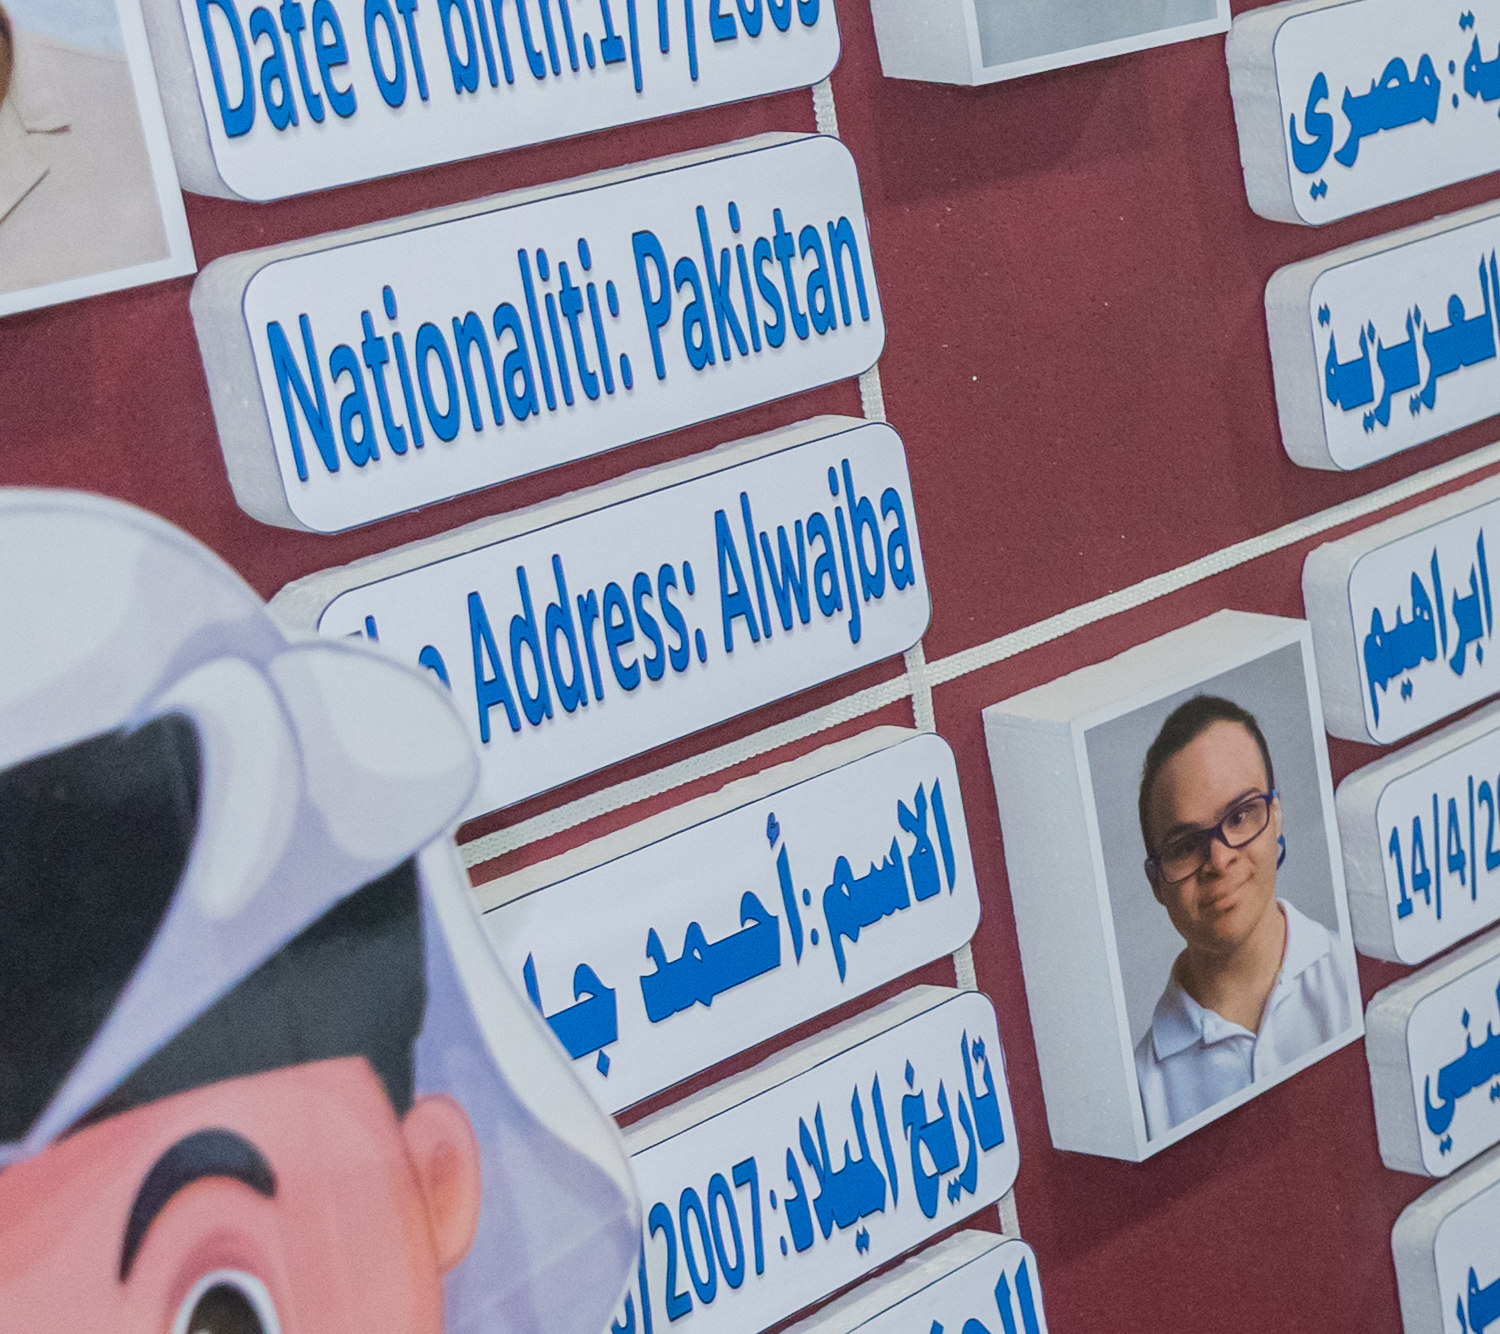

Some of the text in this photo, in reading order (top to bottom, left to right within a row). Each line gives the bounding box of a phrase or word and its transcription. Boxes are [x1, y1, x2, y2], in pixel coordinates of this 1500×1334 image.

[264, 200, 872, 485] Nationaliti: Pakistan
[465, 552, 709, 746] Address:
[712, 456, 917, 655] Alwajba
[1361, 529, 1495, 727] ابراهيم
[637, 779, 958, 1025] الاسم:أحمد
[899, 1030, 1007, 1221] تاريخ
